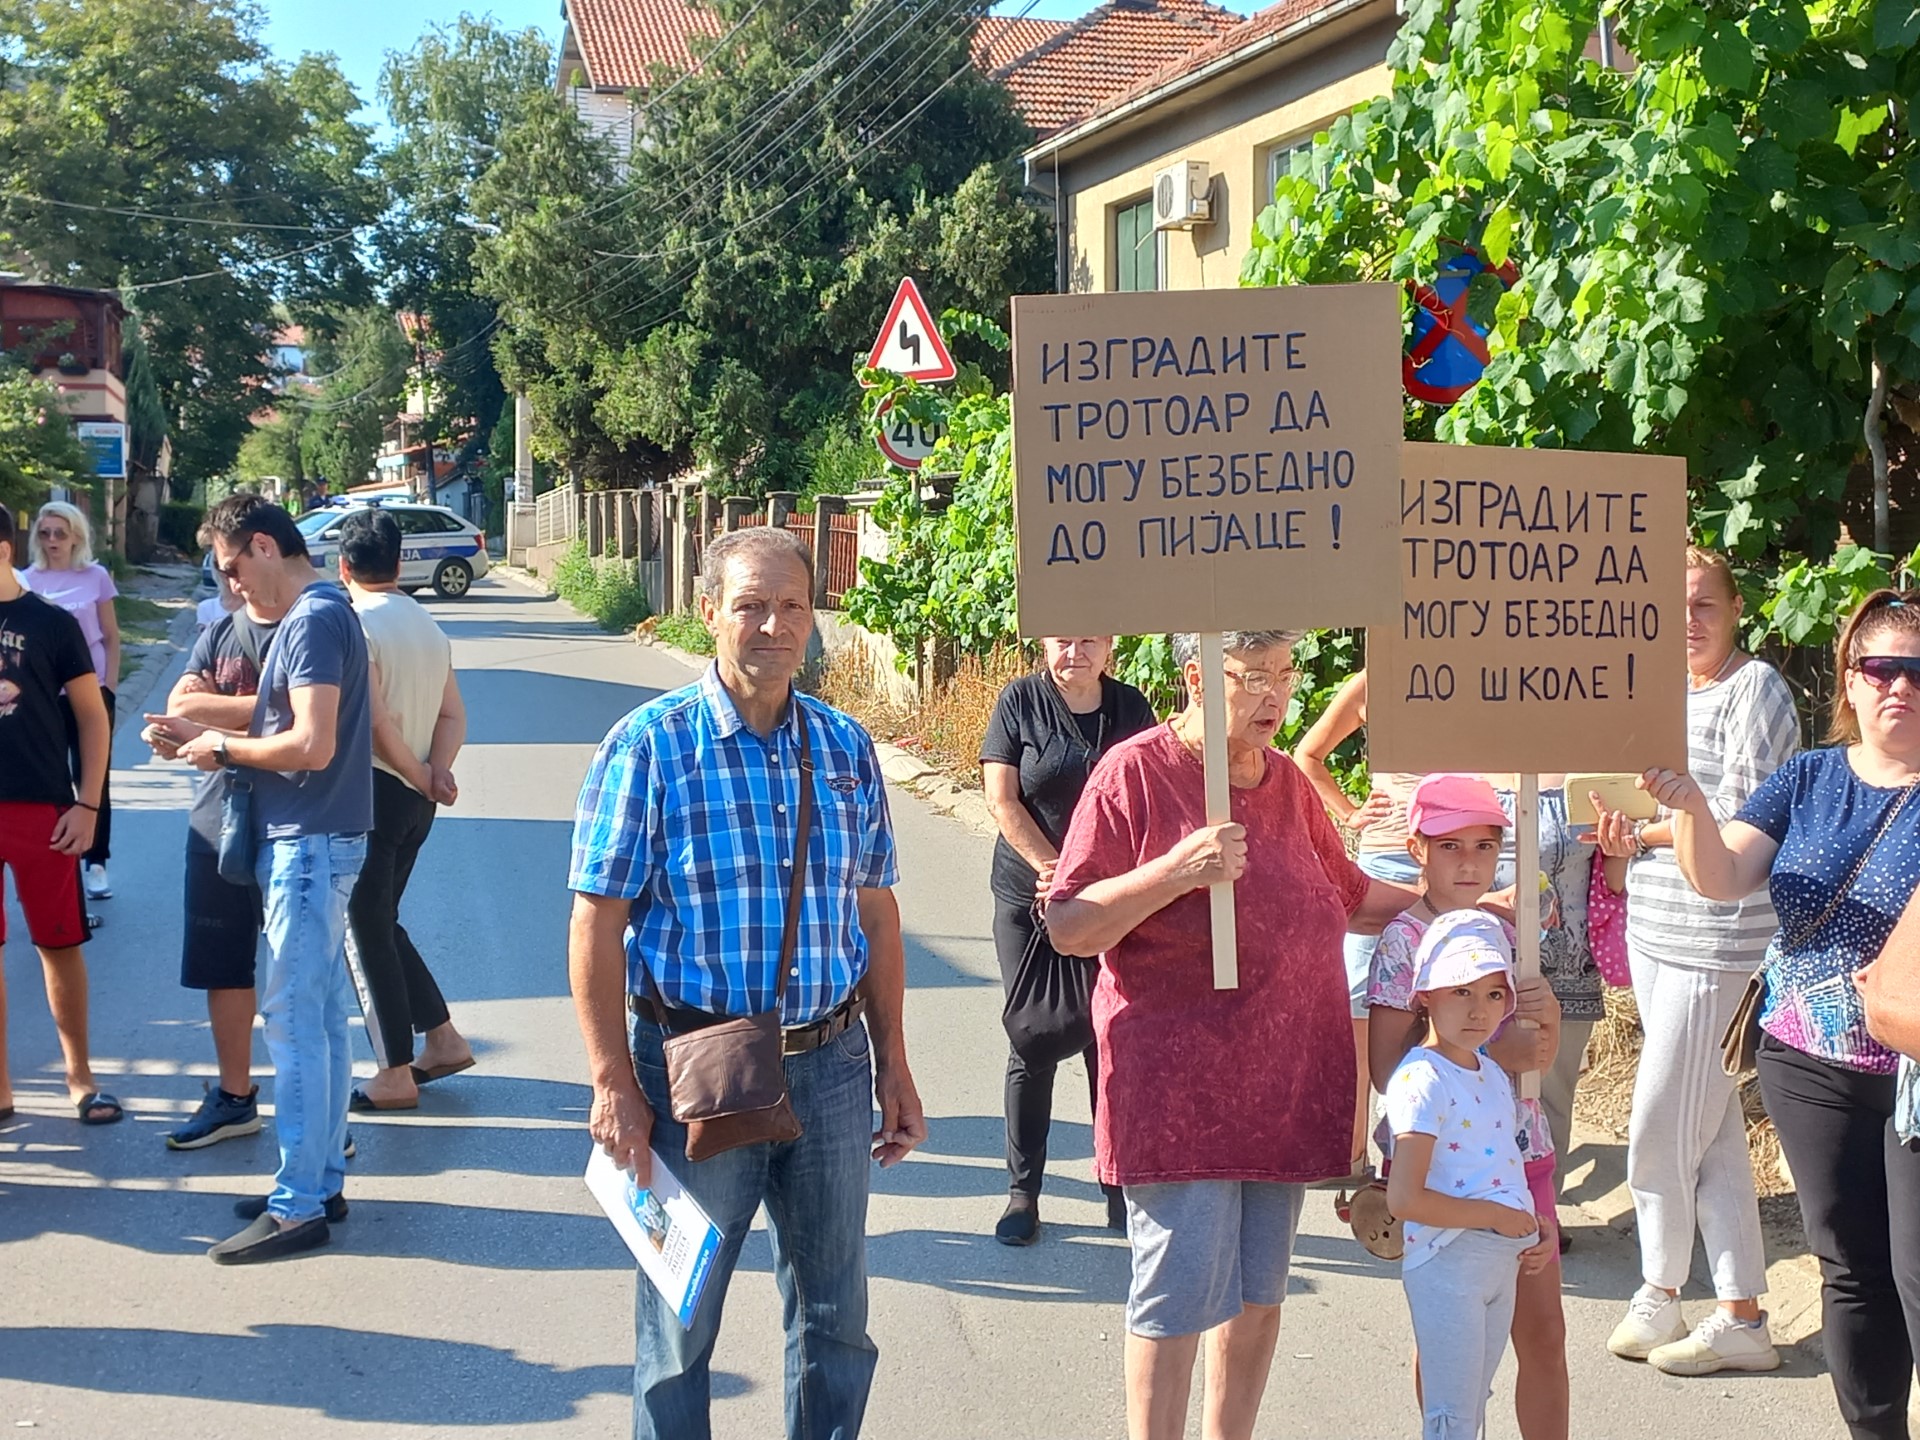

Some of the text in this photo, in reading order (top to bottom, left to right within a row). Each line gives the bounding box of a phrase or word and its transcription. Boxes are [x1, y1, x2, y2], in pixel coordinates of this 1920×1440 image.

[1043, 332, 1307, 385] ИЗГРАДИТЕ
[1040, 389, 1330, 443] ТРОТОАР ДА
[1047, 449, 1355, 504] МОГУ БЕЗБЕДНО
[1400, 478, 1648, 533] ИЗГРАДИТЕ
[400, 549, 421, 560] IJA
[1047, 520, 1106, 566] ДО
[1139, 509, 1306, 558] ПИЈАЦЕ
[1402, 537, 1648, 586] ТРОТОАР ДА
[1404, 599, 1659, 642] МОГУ БЕЗБЕДНО
[1405, 663, 1456, 702] ДО
